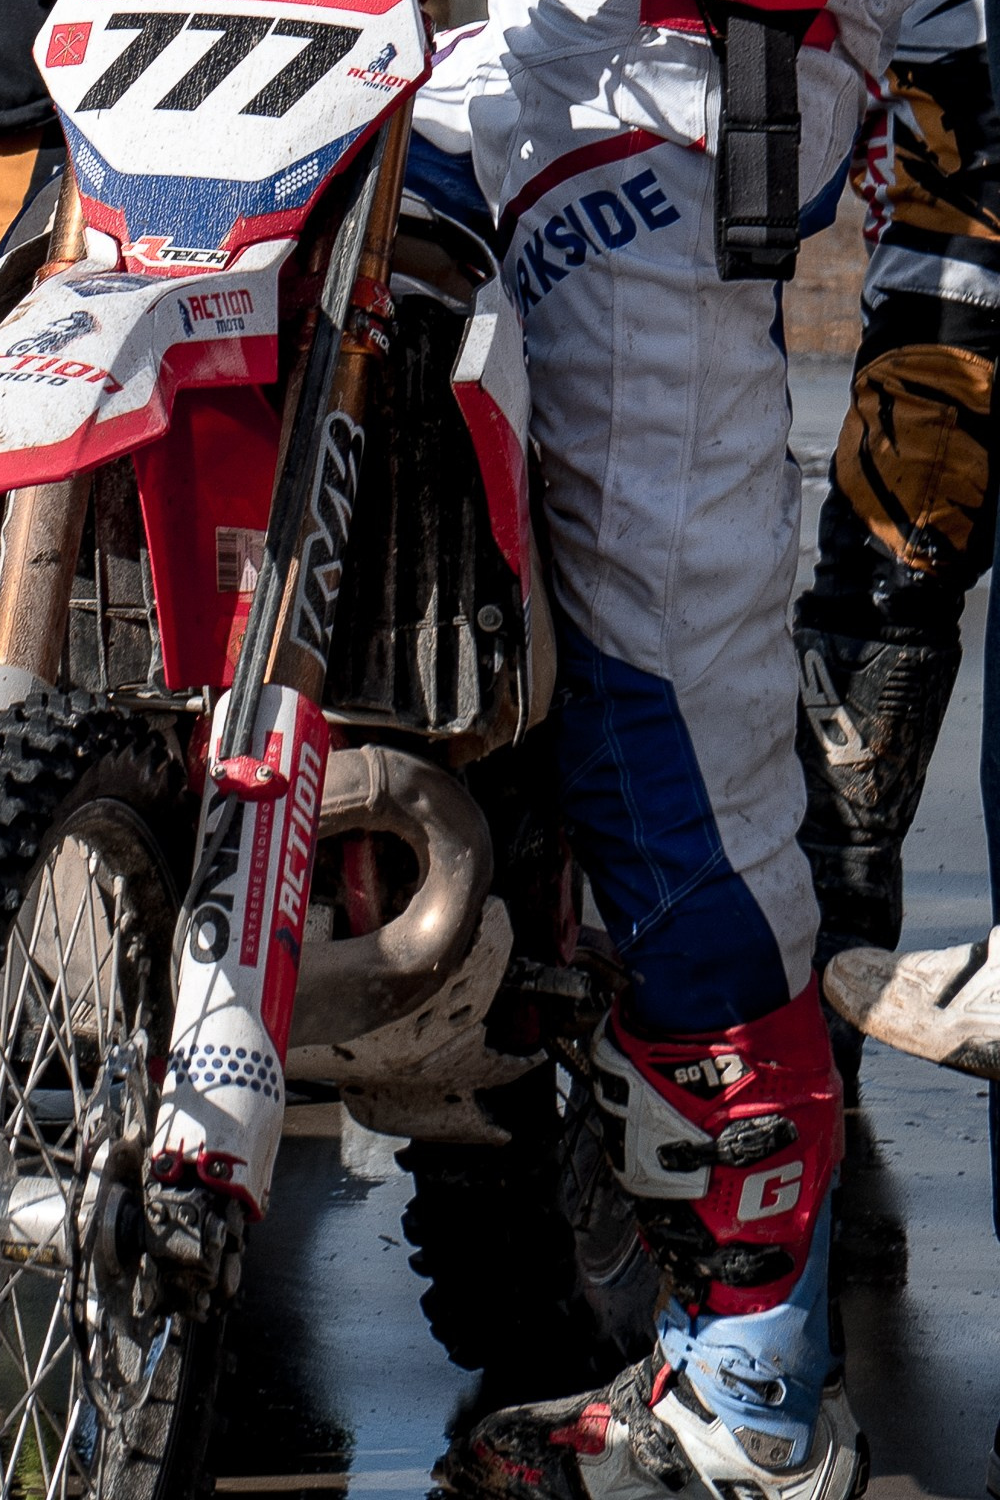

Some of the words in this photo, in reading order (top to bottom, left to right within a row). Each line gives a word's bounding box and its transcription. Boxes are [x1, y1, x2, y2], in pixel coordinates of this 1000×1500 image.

[74, 12, 364, 119] 777
[347, 67, 411, 88] ACTION
[503, 168, 681, 318] RKSIDE
[187, 289, 254, 321] ACTION
[215, 316, 245, 334] MOTO
[278, 741, 322, 927] ACTION
[245, 876, 263, 953] EXTREME
[254, 803, 271, 869] ENDURO
[737, 1161, 803, 1222] G
